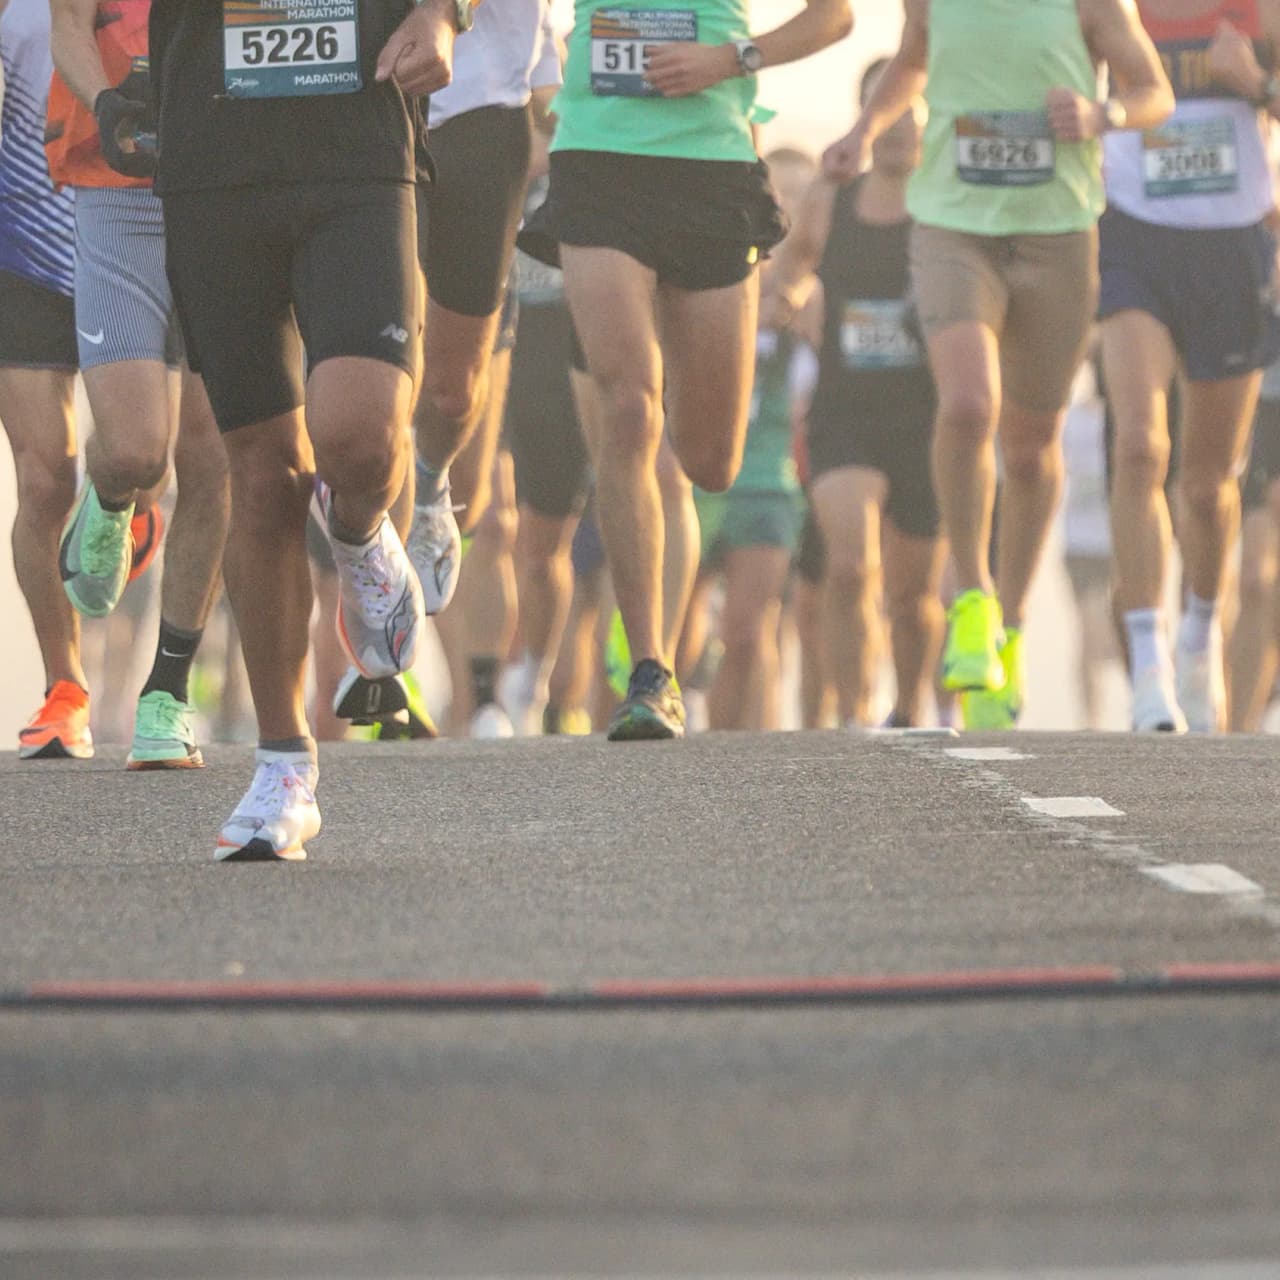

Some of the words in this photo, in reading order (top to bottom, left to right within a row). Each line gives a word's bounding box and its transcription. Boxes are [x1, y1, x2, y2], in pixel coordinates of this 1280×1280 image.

[287, 6, 354, 20] MARATHON
[242, 25, 339, 65] 5226
[295, 72, 358, 86] MARATHON
